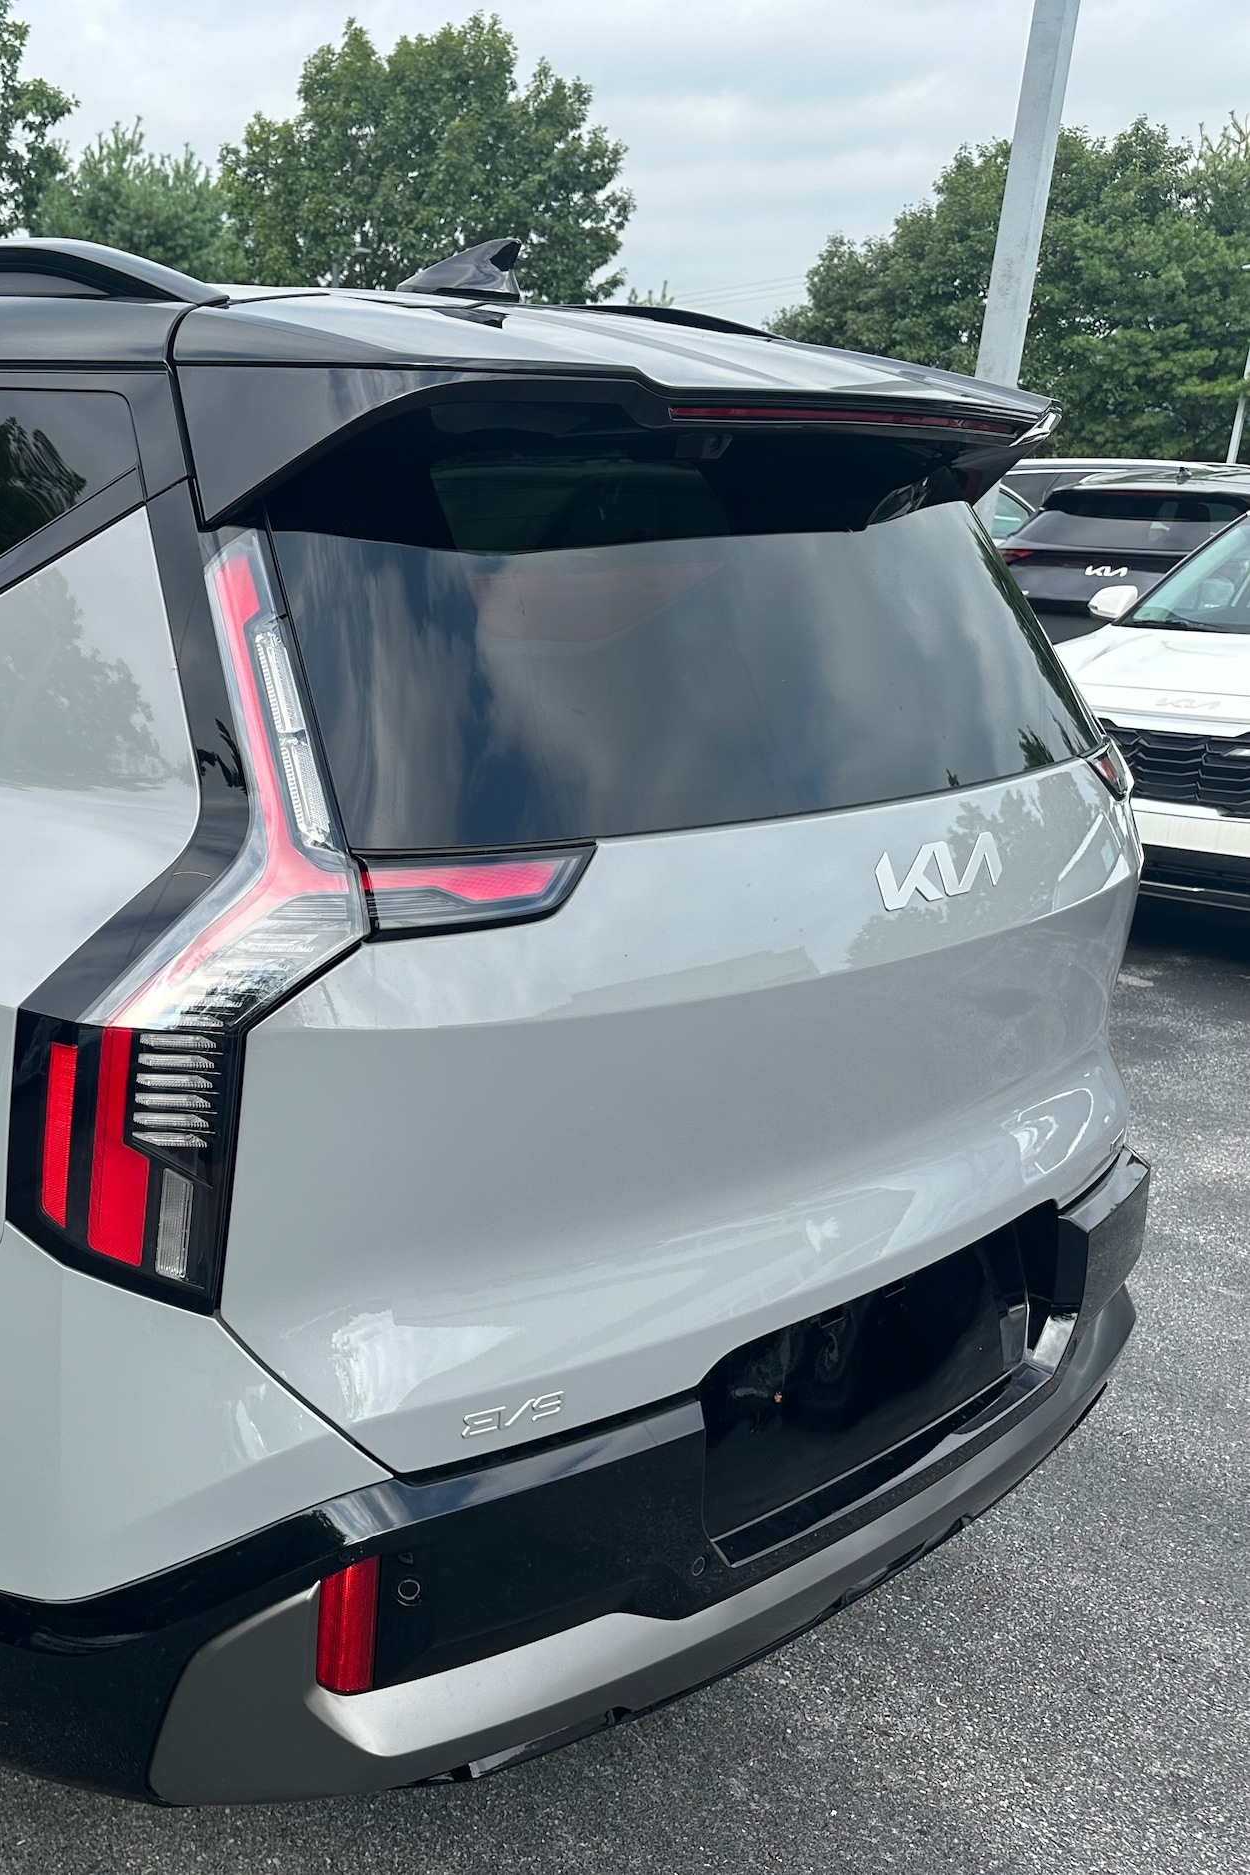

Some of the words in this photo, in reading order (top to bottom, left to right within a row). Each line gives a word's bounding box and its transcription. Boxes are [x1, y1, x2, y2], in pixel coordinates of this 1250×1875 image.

[1085, 565, 1129, 577] KIA
[1155, 697, 1221, 710] KIA
[875, 831, 1003, 912] KIA
[461, 1390, 565, 1439] EV9
